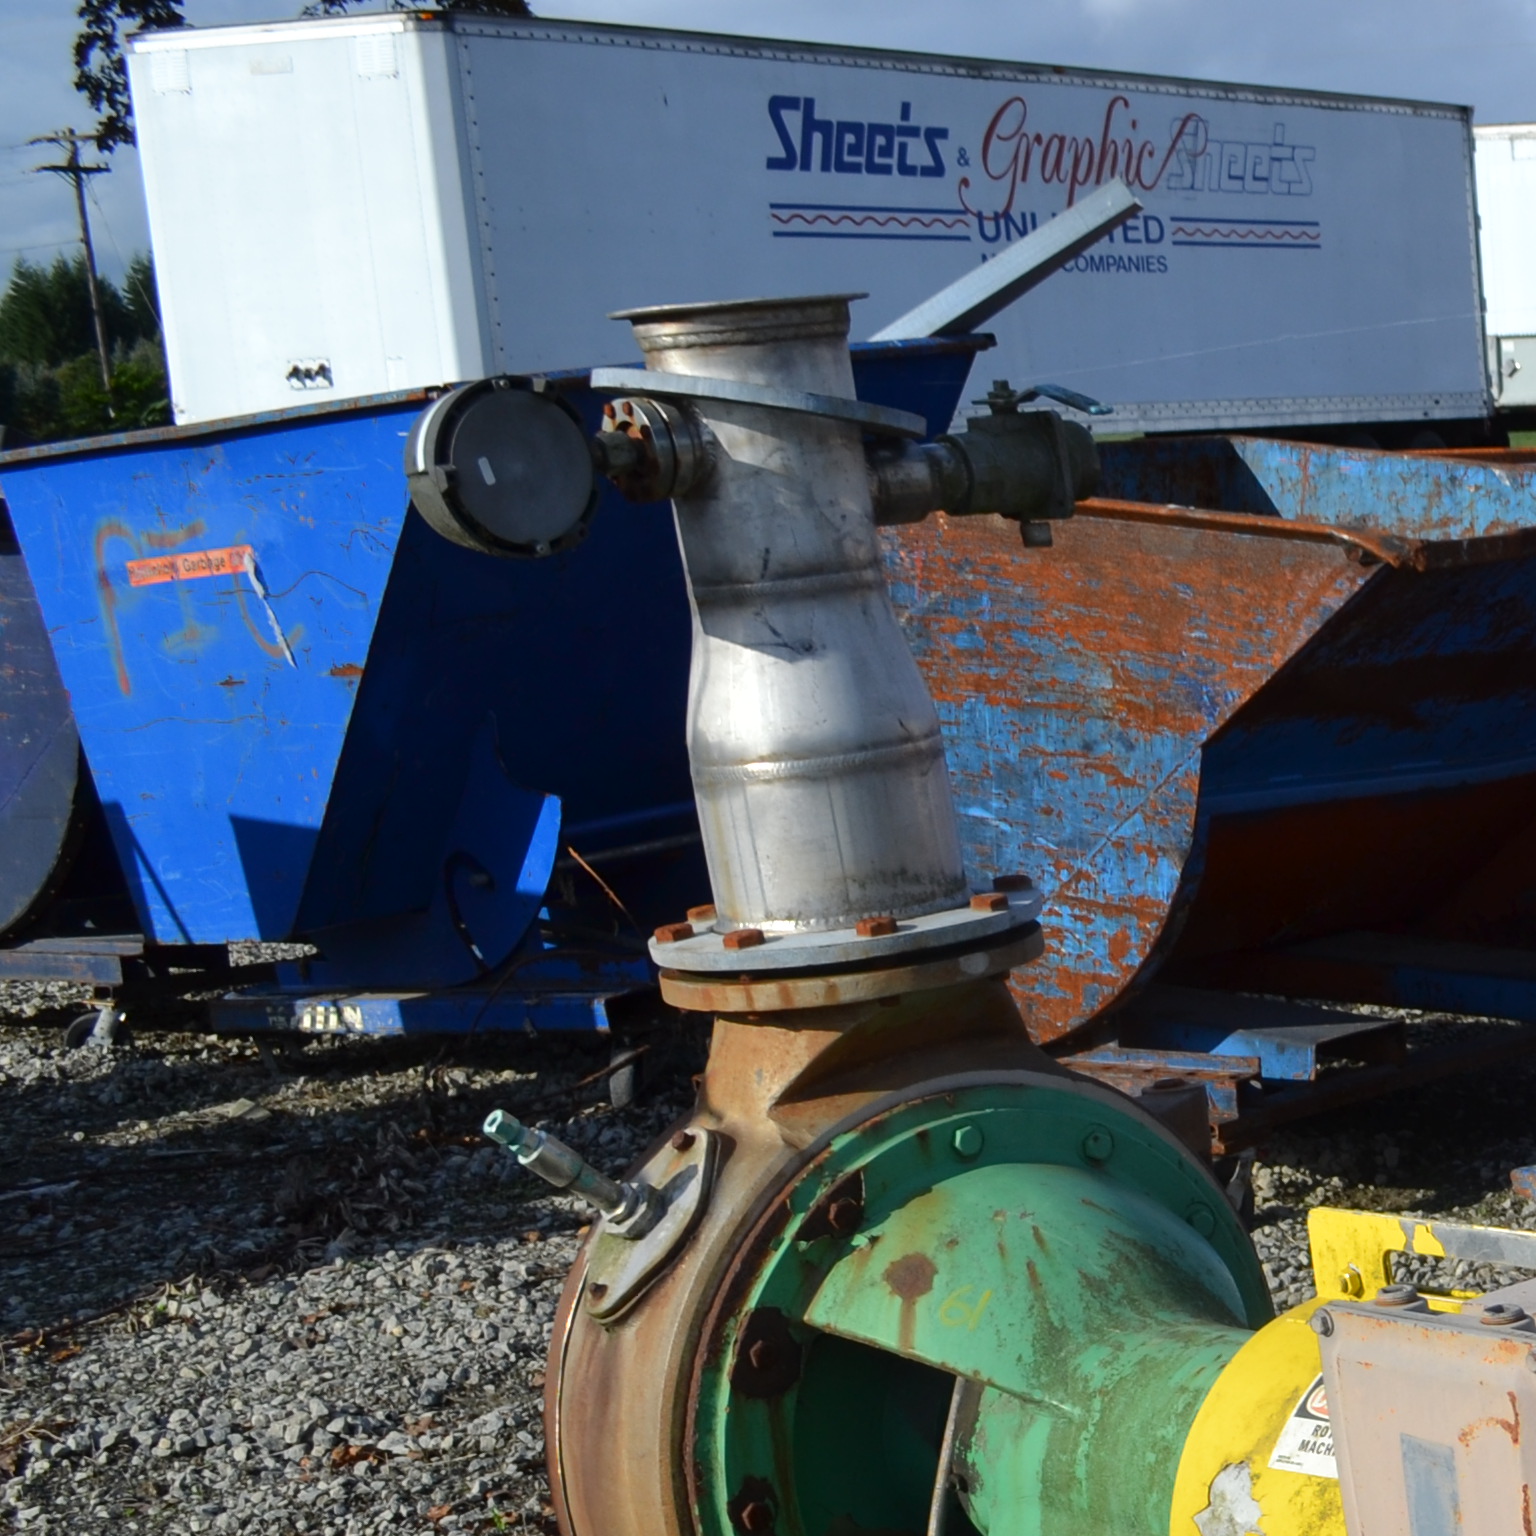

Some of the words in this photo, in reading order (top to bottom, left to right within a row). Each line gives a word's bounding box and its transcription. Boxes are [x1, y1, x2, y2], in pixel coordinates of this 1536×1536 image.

[766, 95, 948, 178] Sheets
[957, 147, 970, 168] &
[182, 554, 225, 574] Garbage
